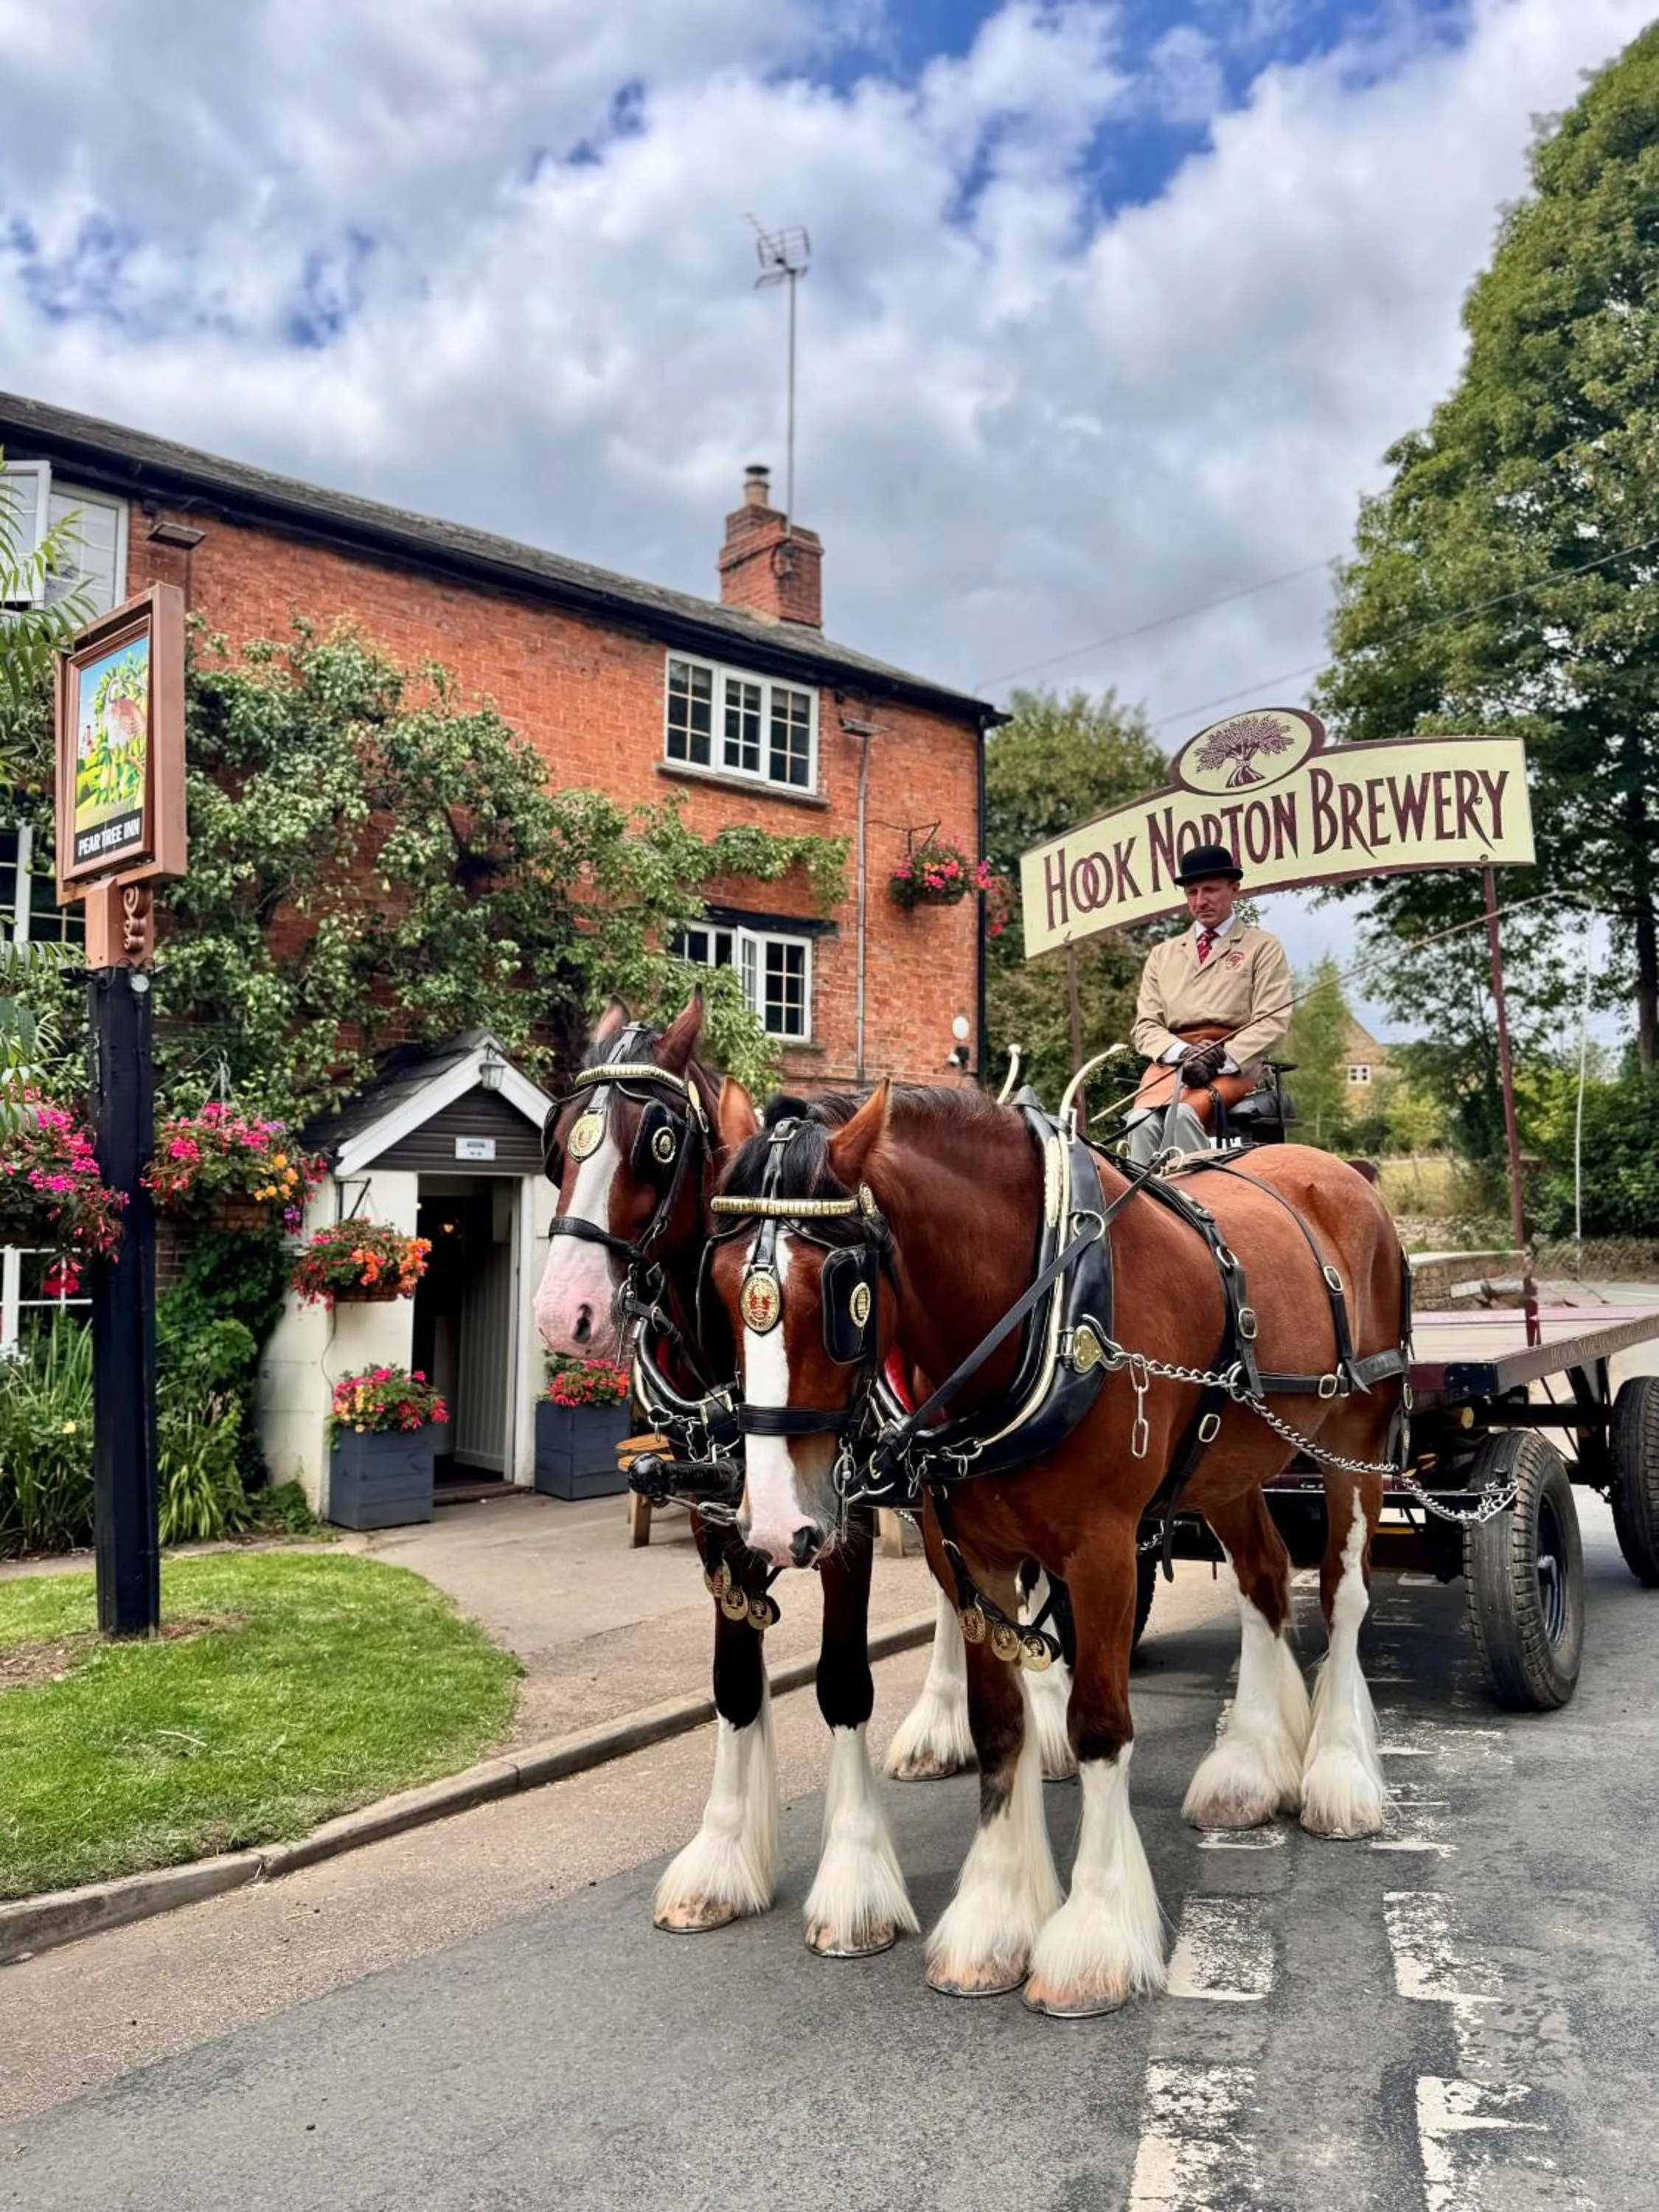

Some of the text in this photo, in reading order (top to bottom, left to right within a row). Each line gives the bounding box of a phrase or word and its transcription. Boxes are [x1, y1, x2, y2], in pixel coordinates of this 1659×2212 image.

[78, 816, 140, 857] PEAR TREE INN
[1043, 836, 1144, 931] HOOK
[1309, 768, 1510, 860] BREWERY
